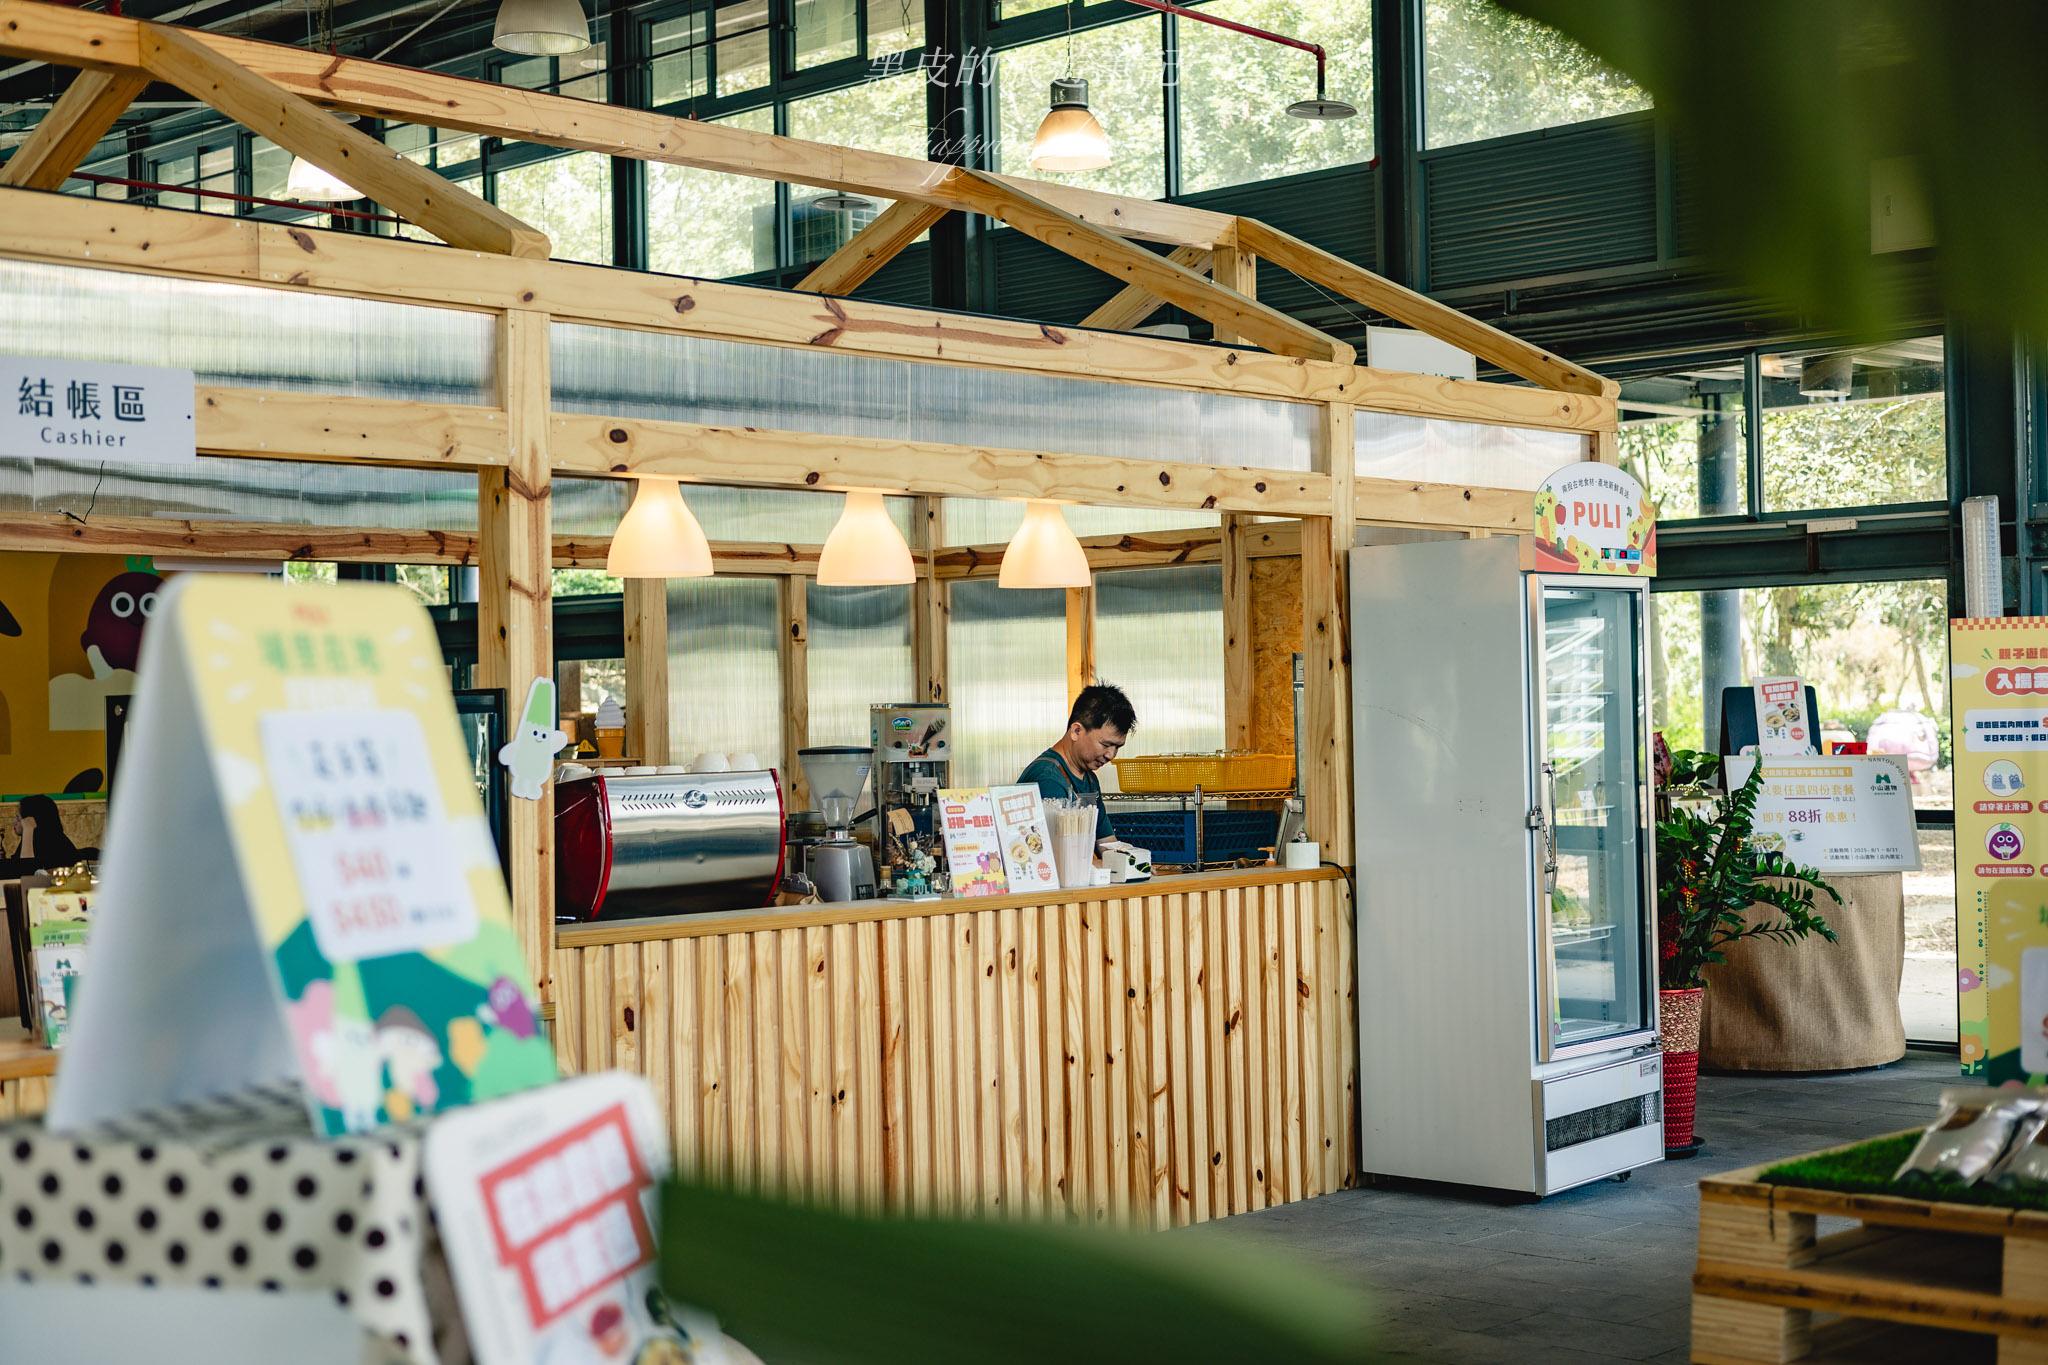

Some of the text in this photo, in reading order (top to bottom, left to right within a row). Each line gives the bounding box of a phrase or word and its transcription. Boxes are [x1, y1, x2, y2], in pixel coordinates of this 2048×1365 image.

[18, 376, 146, 422] 結帳區
[41, 426, 127, 448] Cashier
[1573, 501, 1621, 529] PULI
